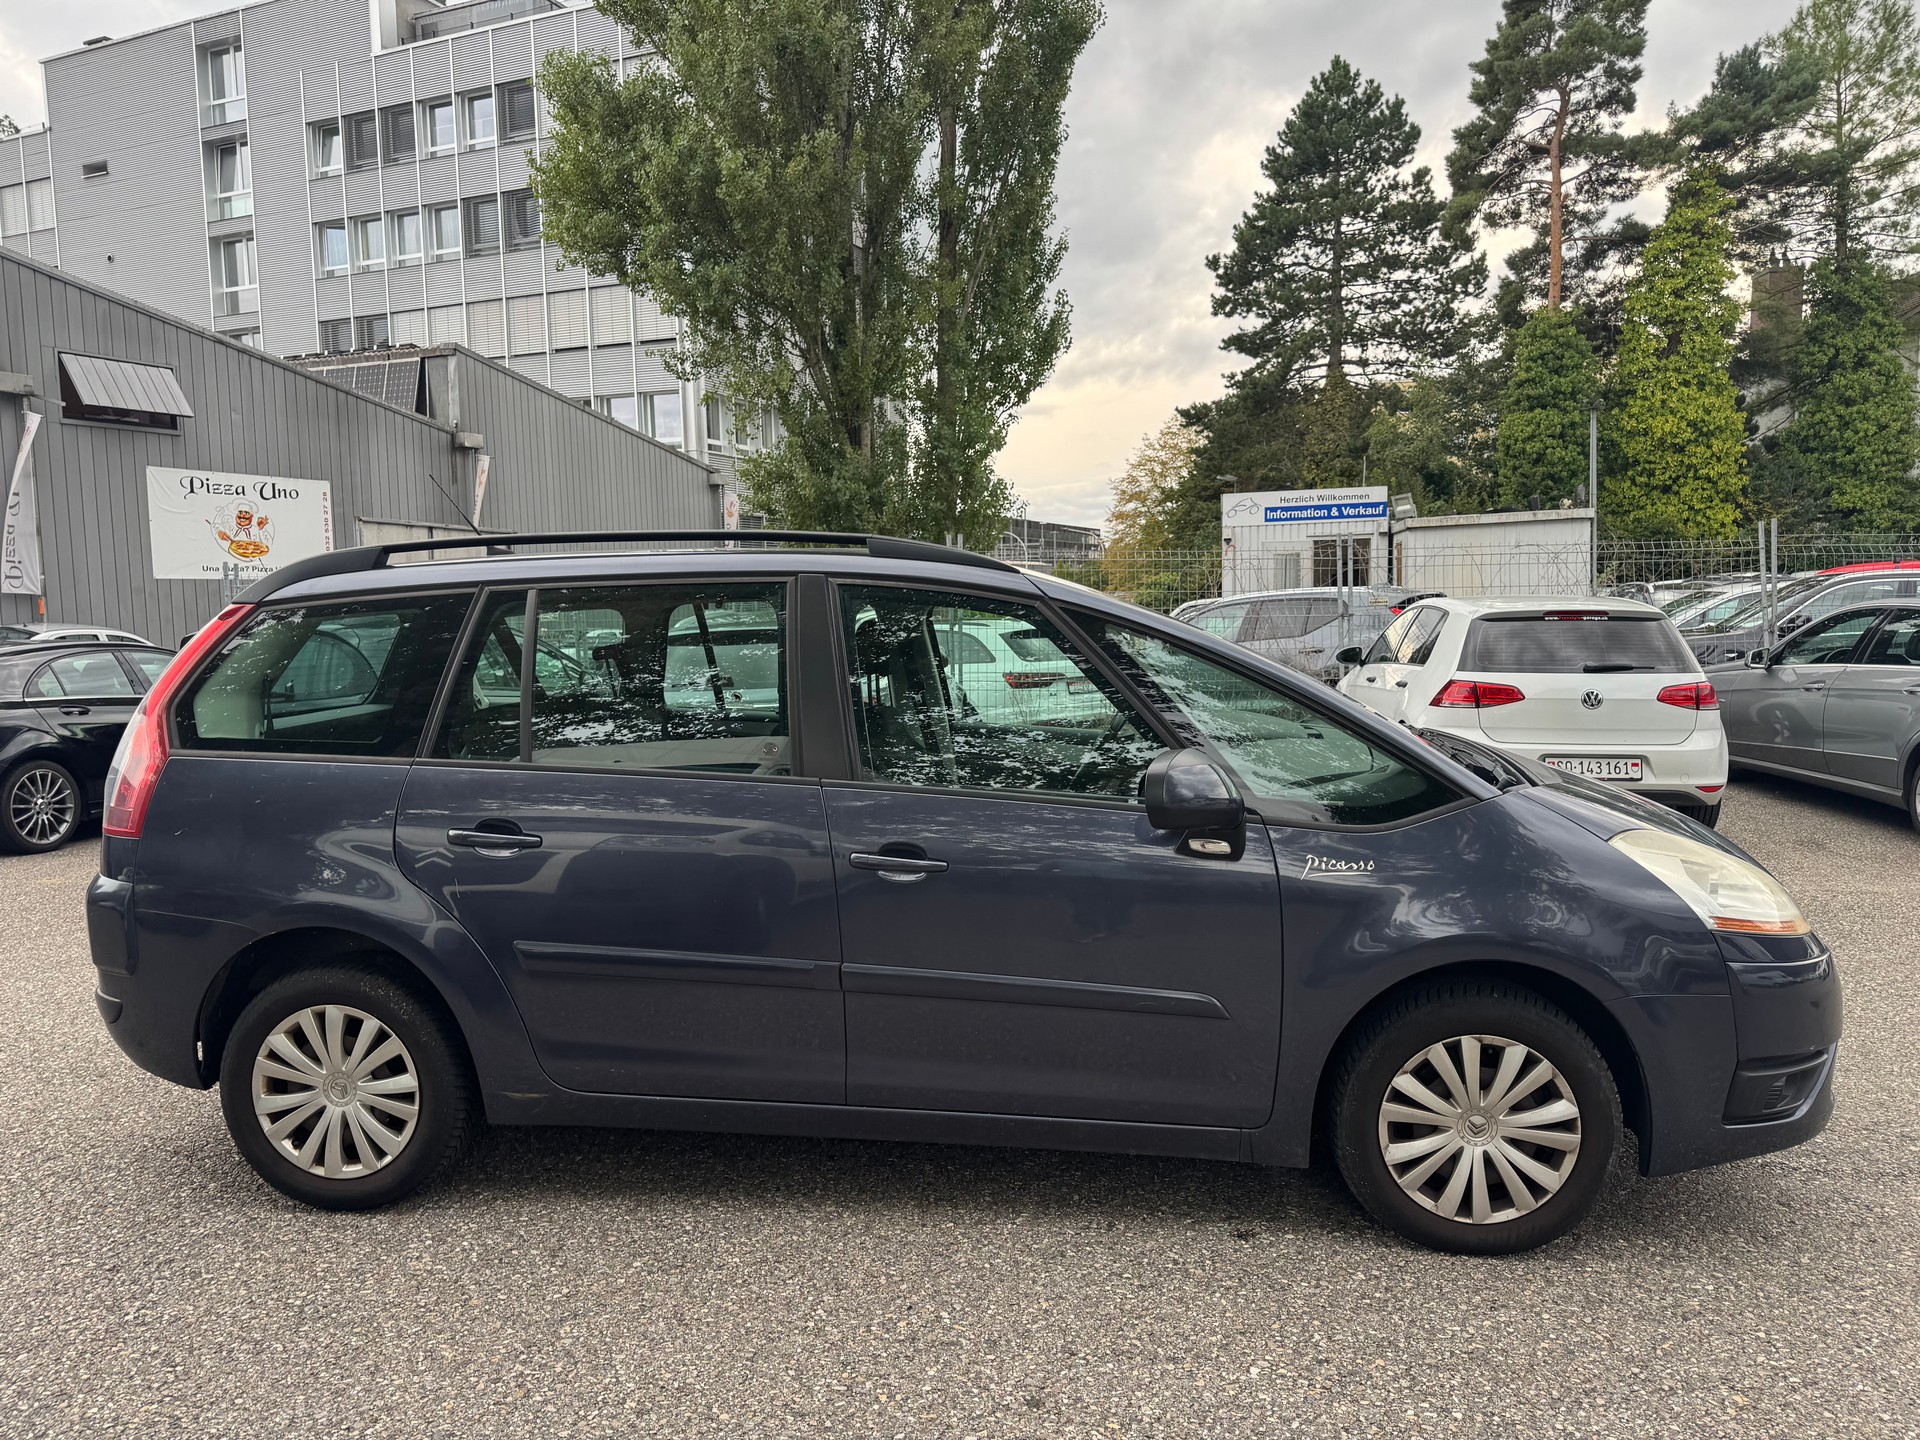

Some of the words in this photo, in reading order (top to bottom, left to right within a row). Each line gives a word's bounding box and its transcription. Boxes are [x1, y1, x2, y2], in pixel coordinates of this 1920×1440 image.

[180, 476, 246, 500] Pizza
[253, 482, 299, 500] Uno
[322, 491, 328, 502] 28
[1279, 495, 1314, 504] Herzlich
[1317, 493, 1370, 502] Willkommen
[323, 505, 328, 515] 27
[1266, 508, 1328, 519] Information
[1330, 507, 1339, 517] &
[1341, 505, 1384, 516] Verkauf
[251, 565, 274, 573] Pizza
[1300, 854, 1375, 880] Picasso
